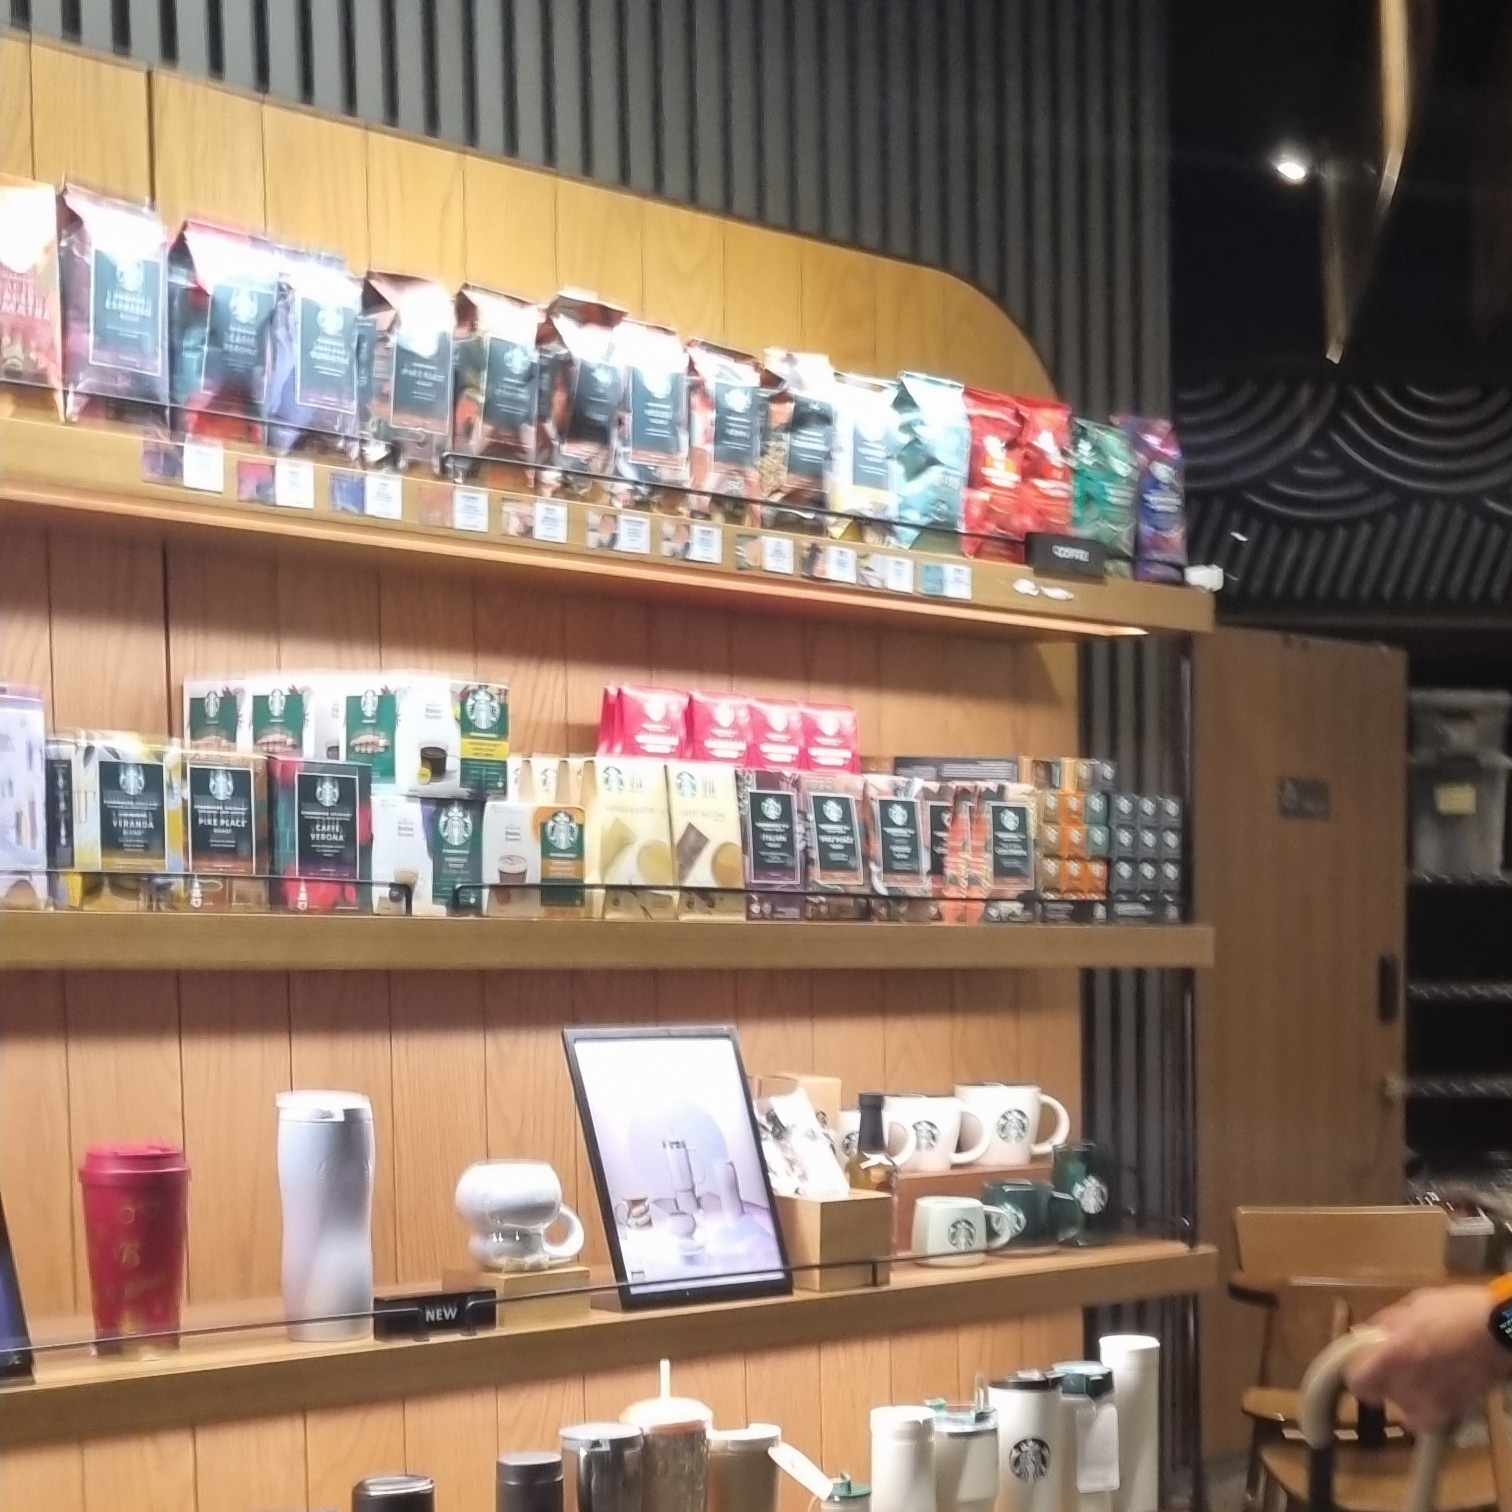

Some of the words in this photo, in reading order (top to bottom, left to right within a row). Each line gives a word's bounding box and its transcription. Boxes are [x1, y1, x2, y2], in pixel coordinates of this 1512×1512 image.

[198, 817, 217, 827] PIKE
[220, 818, 247, 828] PLACE
[311, 833, 344, 841] VERONA
[425, 1307, 457, 1322] NEW
